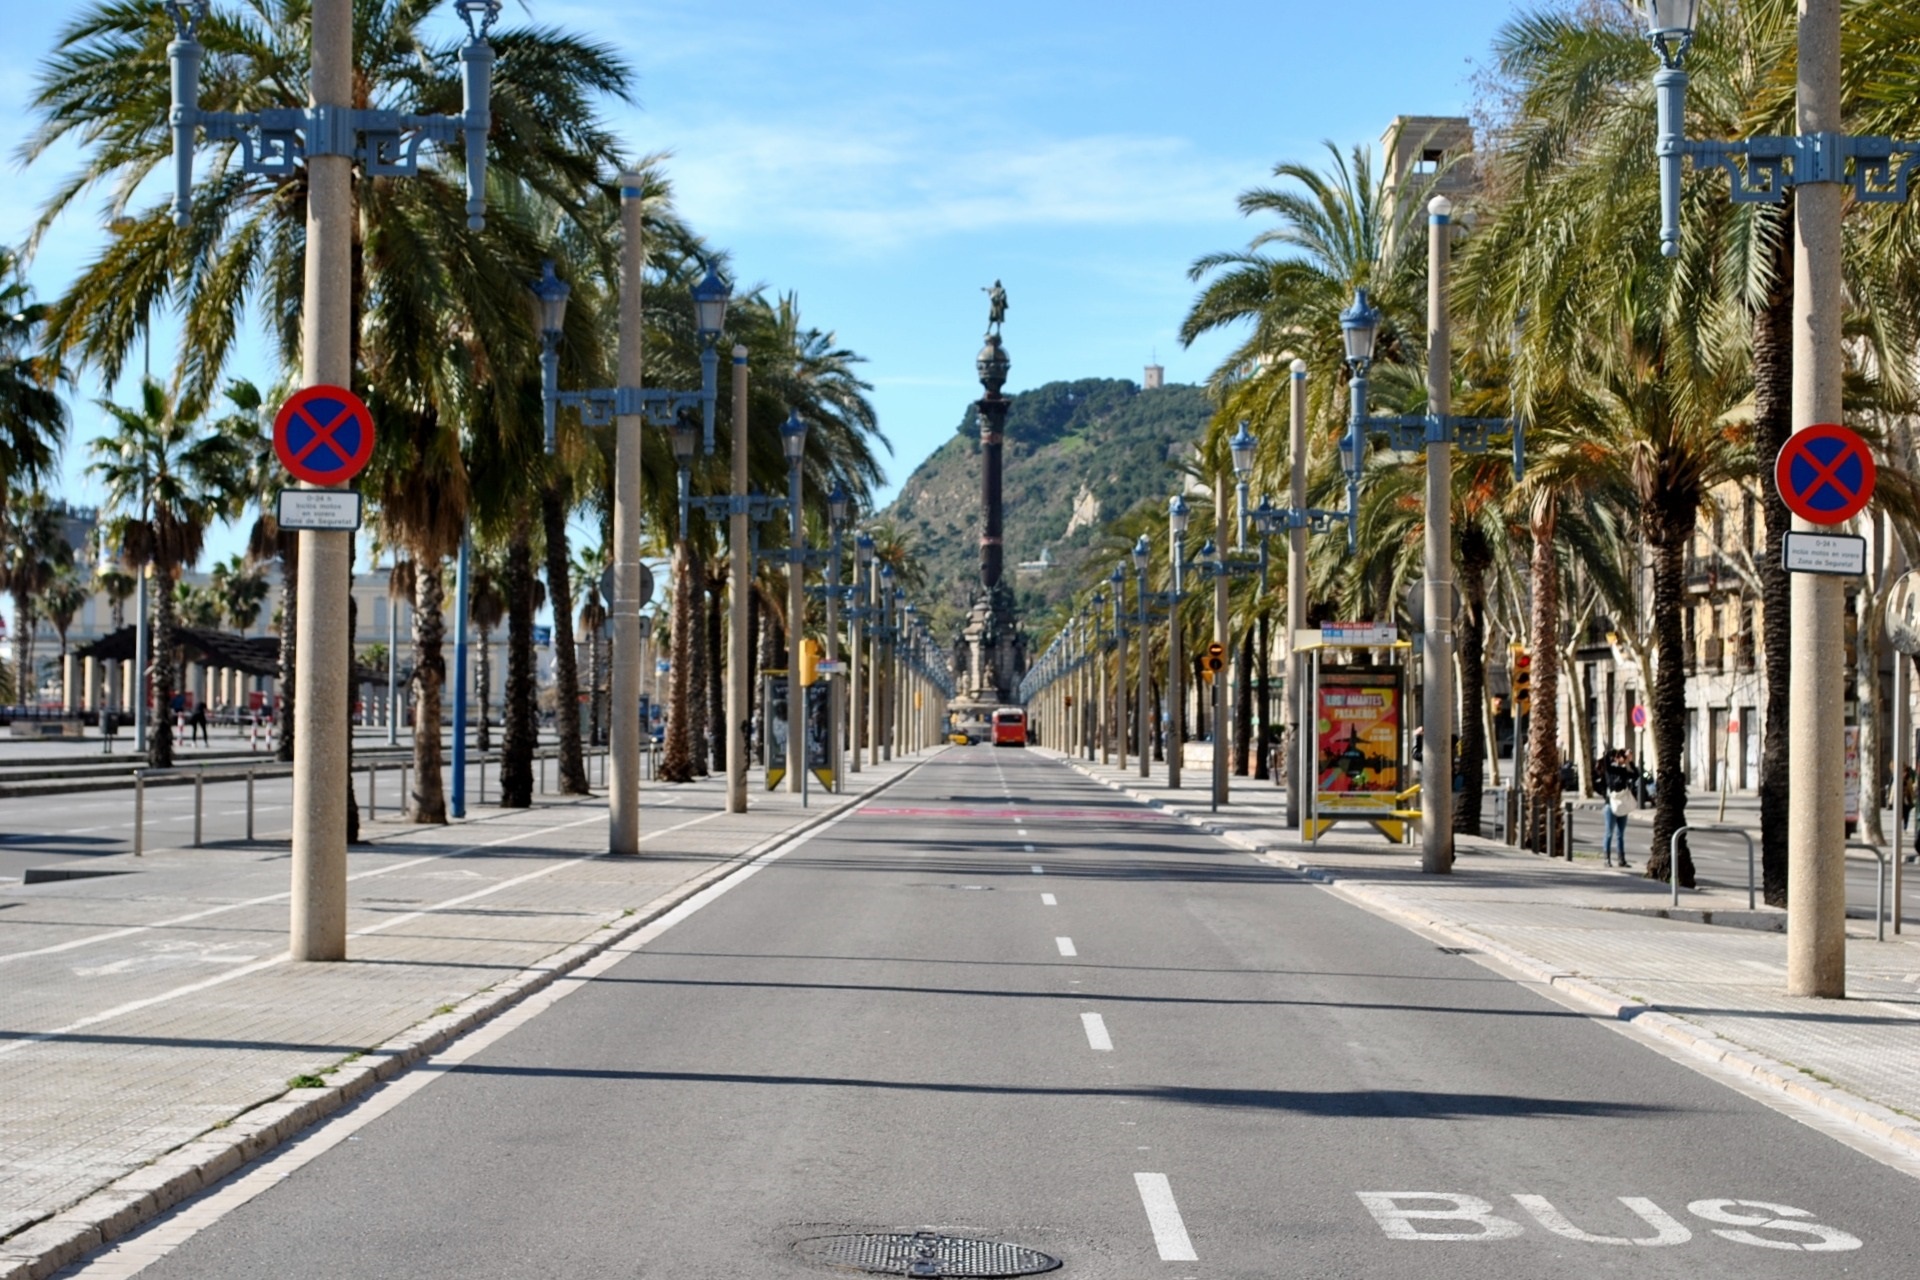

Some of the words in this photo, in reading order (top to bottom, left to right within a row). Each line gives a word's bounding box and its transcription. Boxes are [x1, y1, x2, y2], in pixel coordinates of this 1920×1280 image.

[285, 516, 303, 524] Zona
[318, 518, 352, 527] Seguretat
[1797, 557, 1813, 565] Zona
[1346, 695, 1382, 706] AMANTES
[1355, 1190, 1864, 1253] BUS
